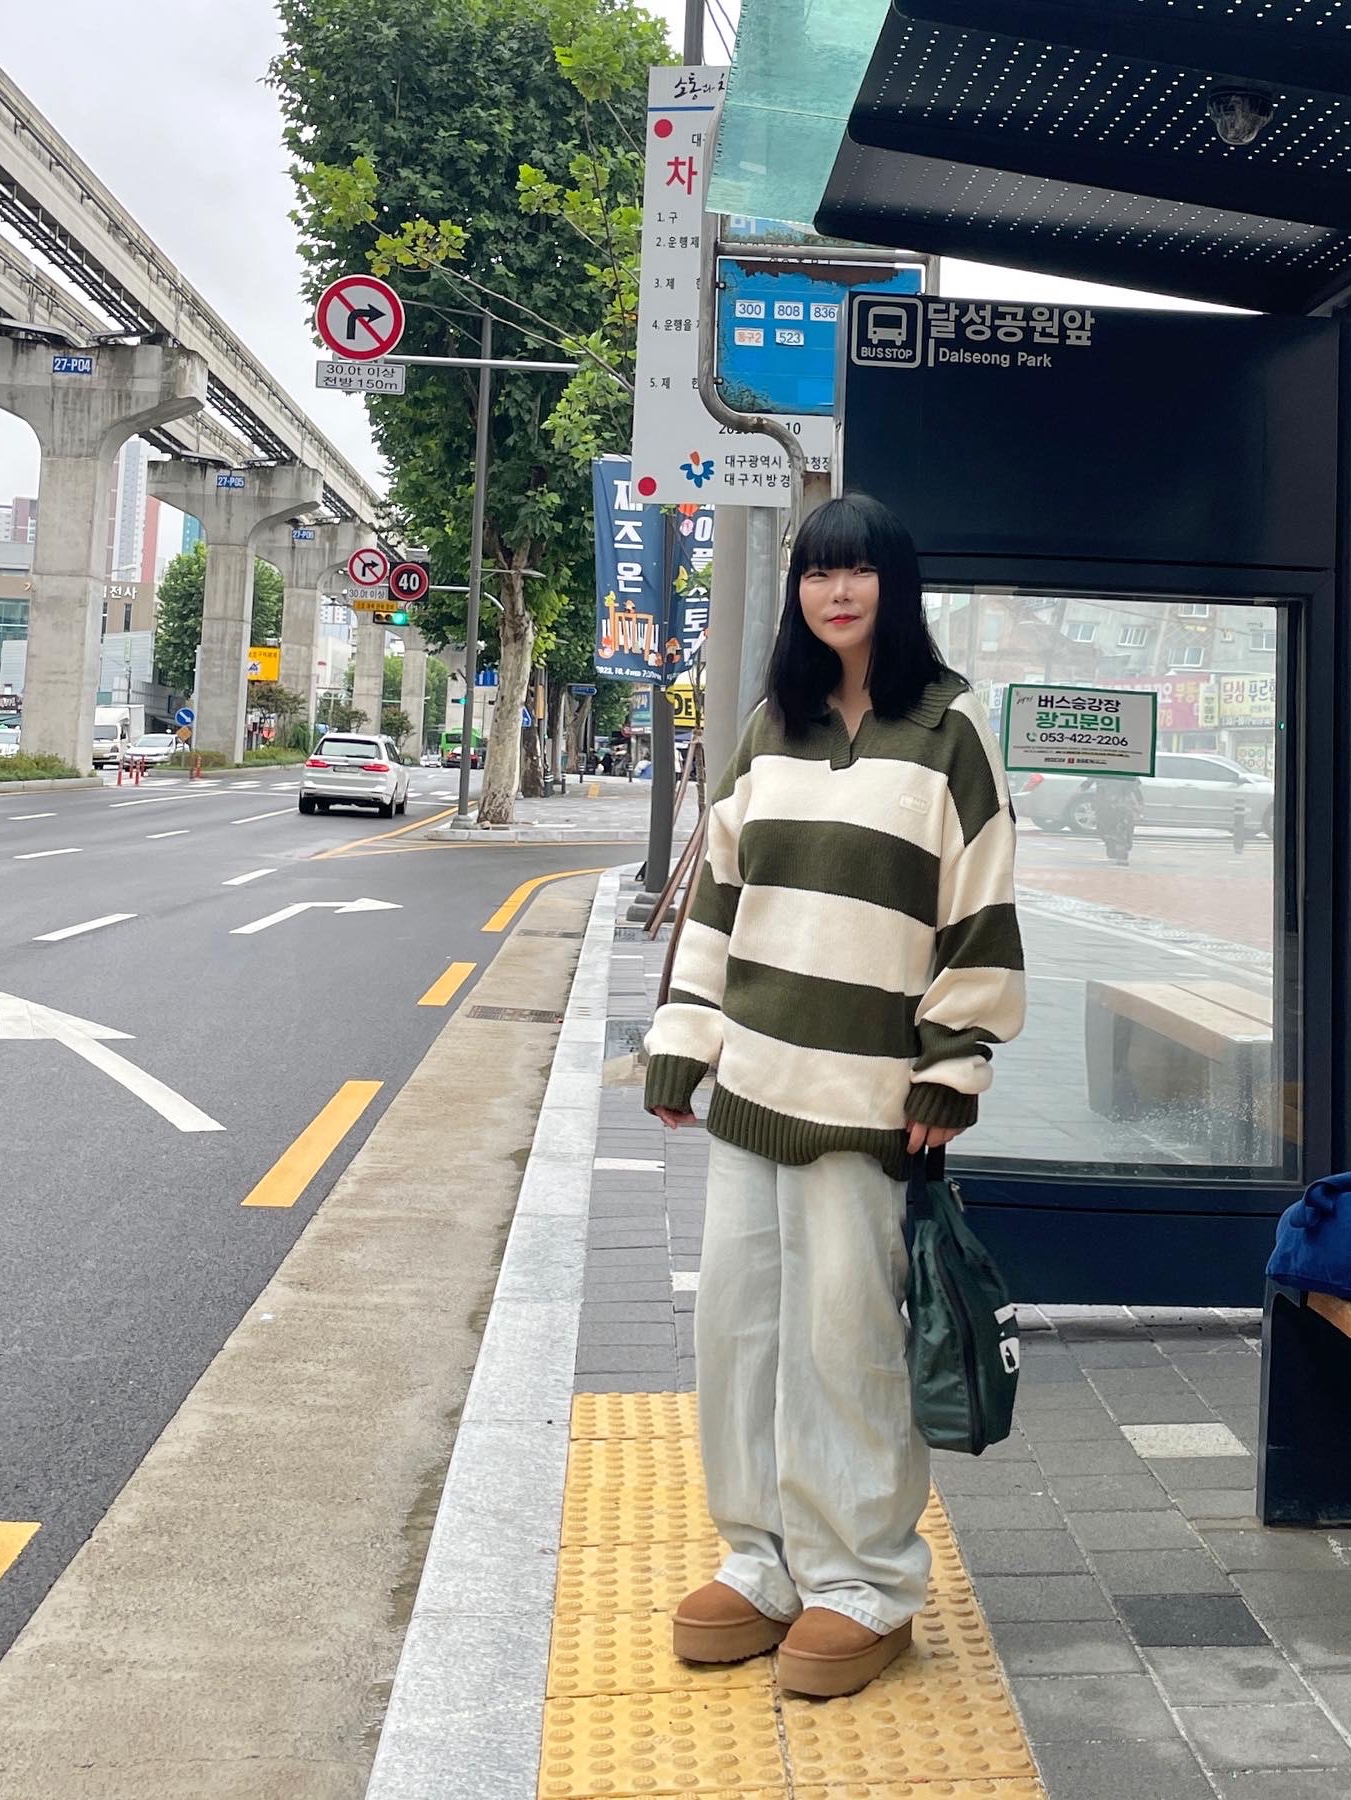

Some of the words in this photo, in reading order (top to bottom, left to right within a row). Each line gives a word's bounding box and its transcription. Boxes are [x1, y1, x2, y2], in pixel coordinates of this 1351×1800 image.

[665, 155, 698, 196] 차
[739, 304, 762, 315] 300
[777, 305, 800, 316] 808
[813, 307, 836, 319] 836
[663, 318, 692, 332] 운행을
[927, 302, 1095, 346] 달성공원앞
[779, 332, 800, 344] 523
[54, 358, 91, 372] 27-P04
[939, 347, 1010, 367] Dalseong
[1017, 351, 1053, 368] Park
[326, 364, 361, 376] 30.0t
[367, 366, 396, 379] 이상
[323, 375, 353, 388] 전방
[356, 379, 398, 390] 150m
[725, 455, 782, 469] 대구광역시
[218, 476, 246, 488] 27-P05
[398, 573, 420, 591] 40
[1037, 694, 1121, 713] 버스승강장
[1035, 711, 1121, 733] 광고문의
[1040, 732, 1129, 747] 053-422-2206
